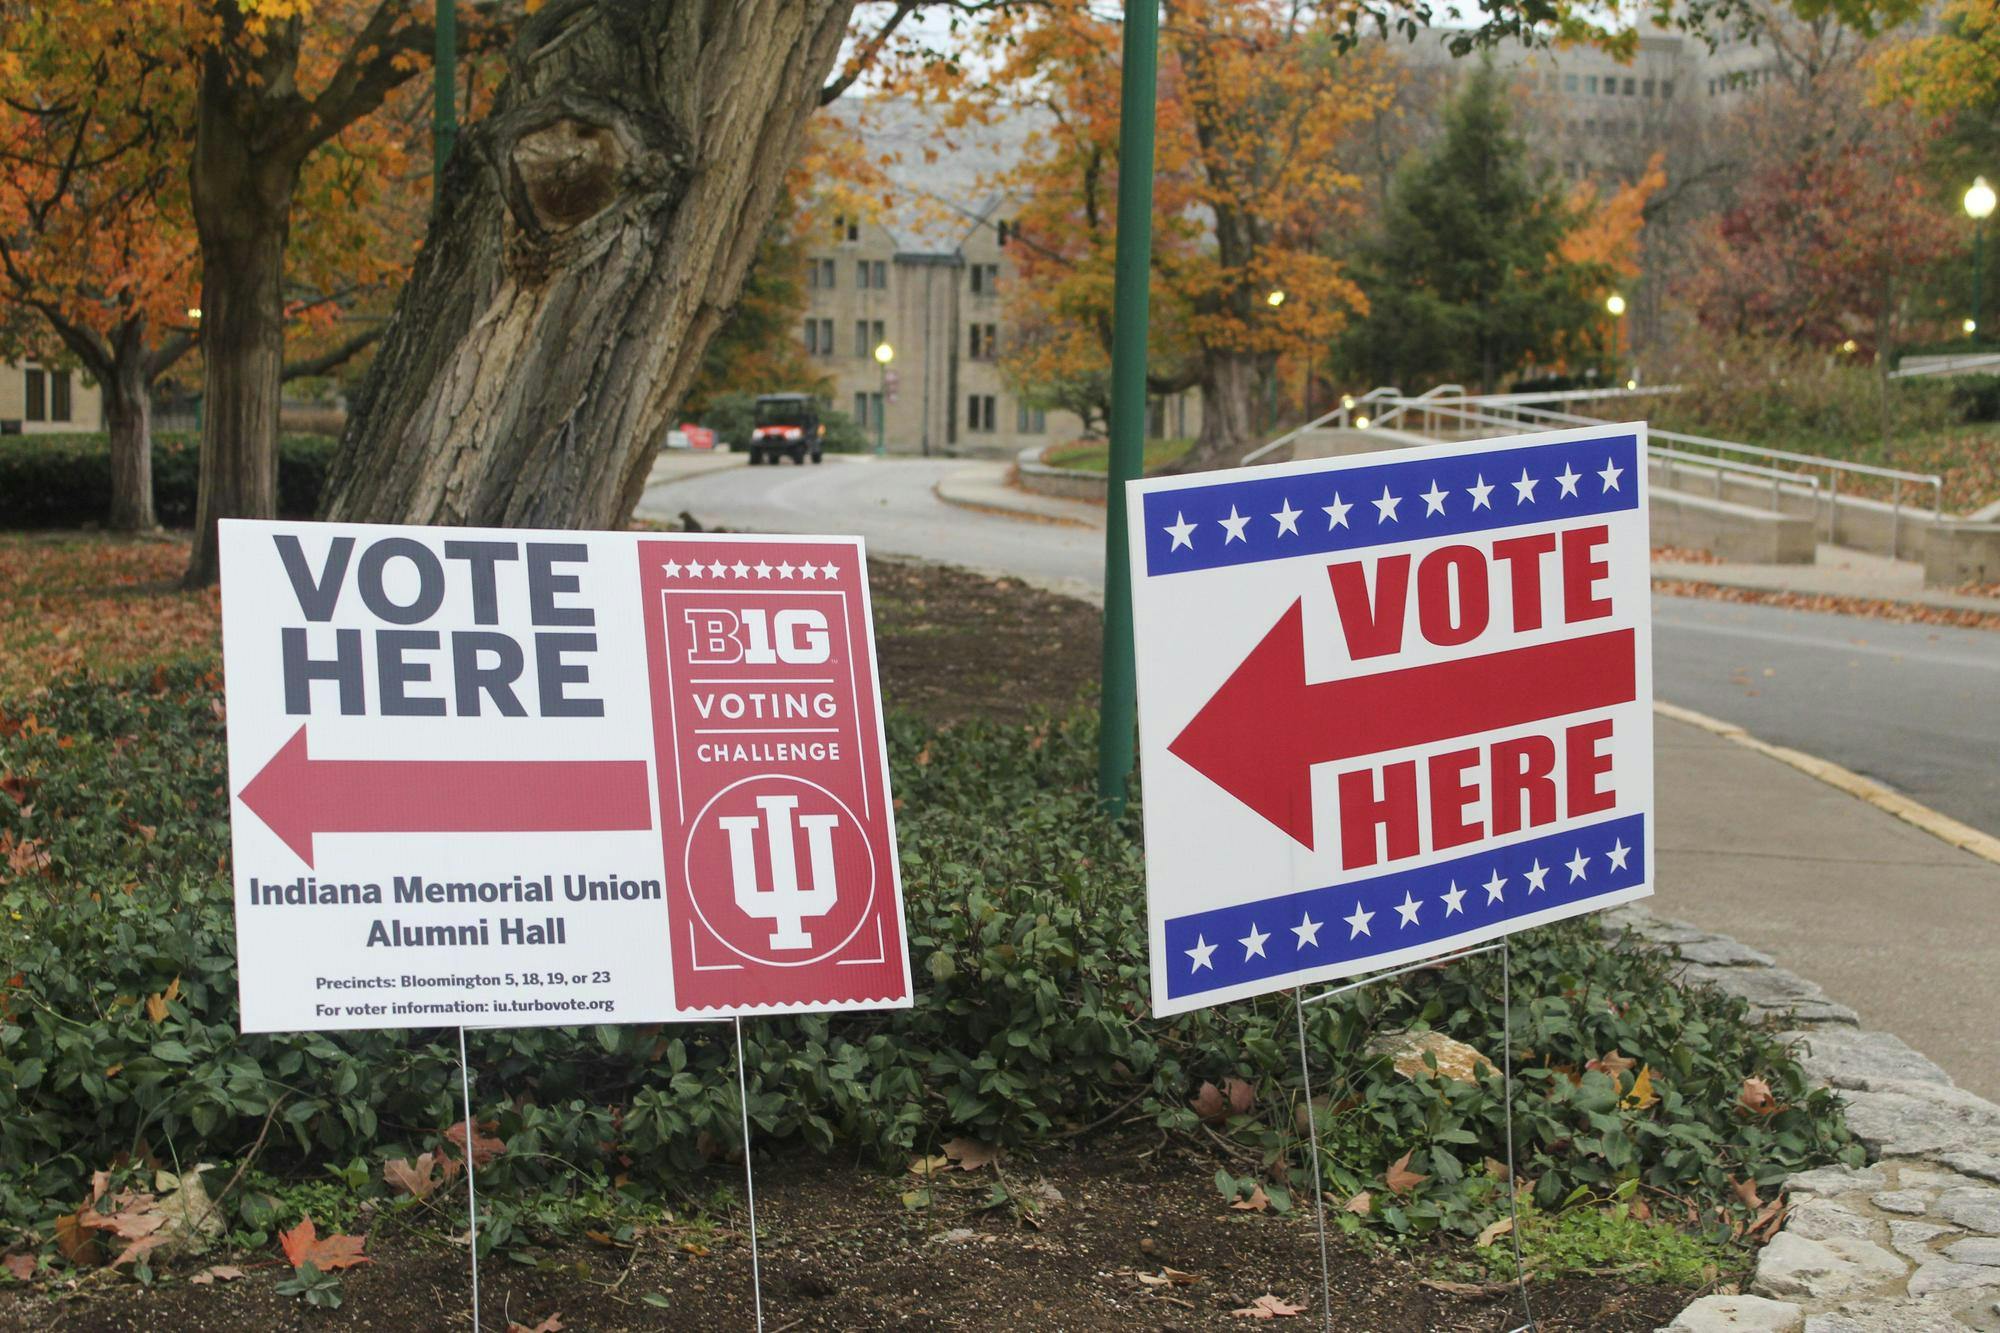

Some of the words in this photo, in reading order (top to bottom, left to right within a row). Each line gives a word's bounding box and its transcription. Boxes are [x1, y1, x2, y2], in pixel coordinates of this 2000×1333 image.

[272, 535, 596, 626] VOTE
[1327, 524, 1613, 661] VOTE
[281, 628, 605, 717] HERE
[693, 693, 837, 720] VOTING
[697, 743, 840, 762] CHALLENGE
[1338, 718, 1616, 870] HERE
[250, 878, 382, 905] Indiana
[394, 875, 552, 903] Memorial
[564, 874, 661, 900] Union
[366, 918, 488, 947] Alumni
[500, 918, 566, 945] Hall
[316, 976, 396, 989] Precincts:
[401, 973, 501, 989] Bloomington
[505, 973, 519, 987] 5,
[523, 972, 543, 987] 18,
[548, 971, 568, 987] 19,
[572, 973, 587, 984] or
[592, 971, 611, 983] 23
[316, 1003, 341, 1017] For
[346, 1002, 387, 1016] voter
[392, 1001, 489, 1014] information:
[494, 998, 614, 1014] iu.turbovote.org
